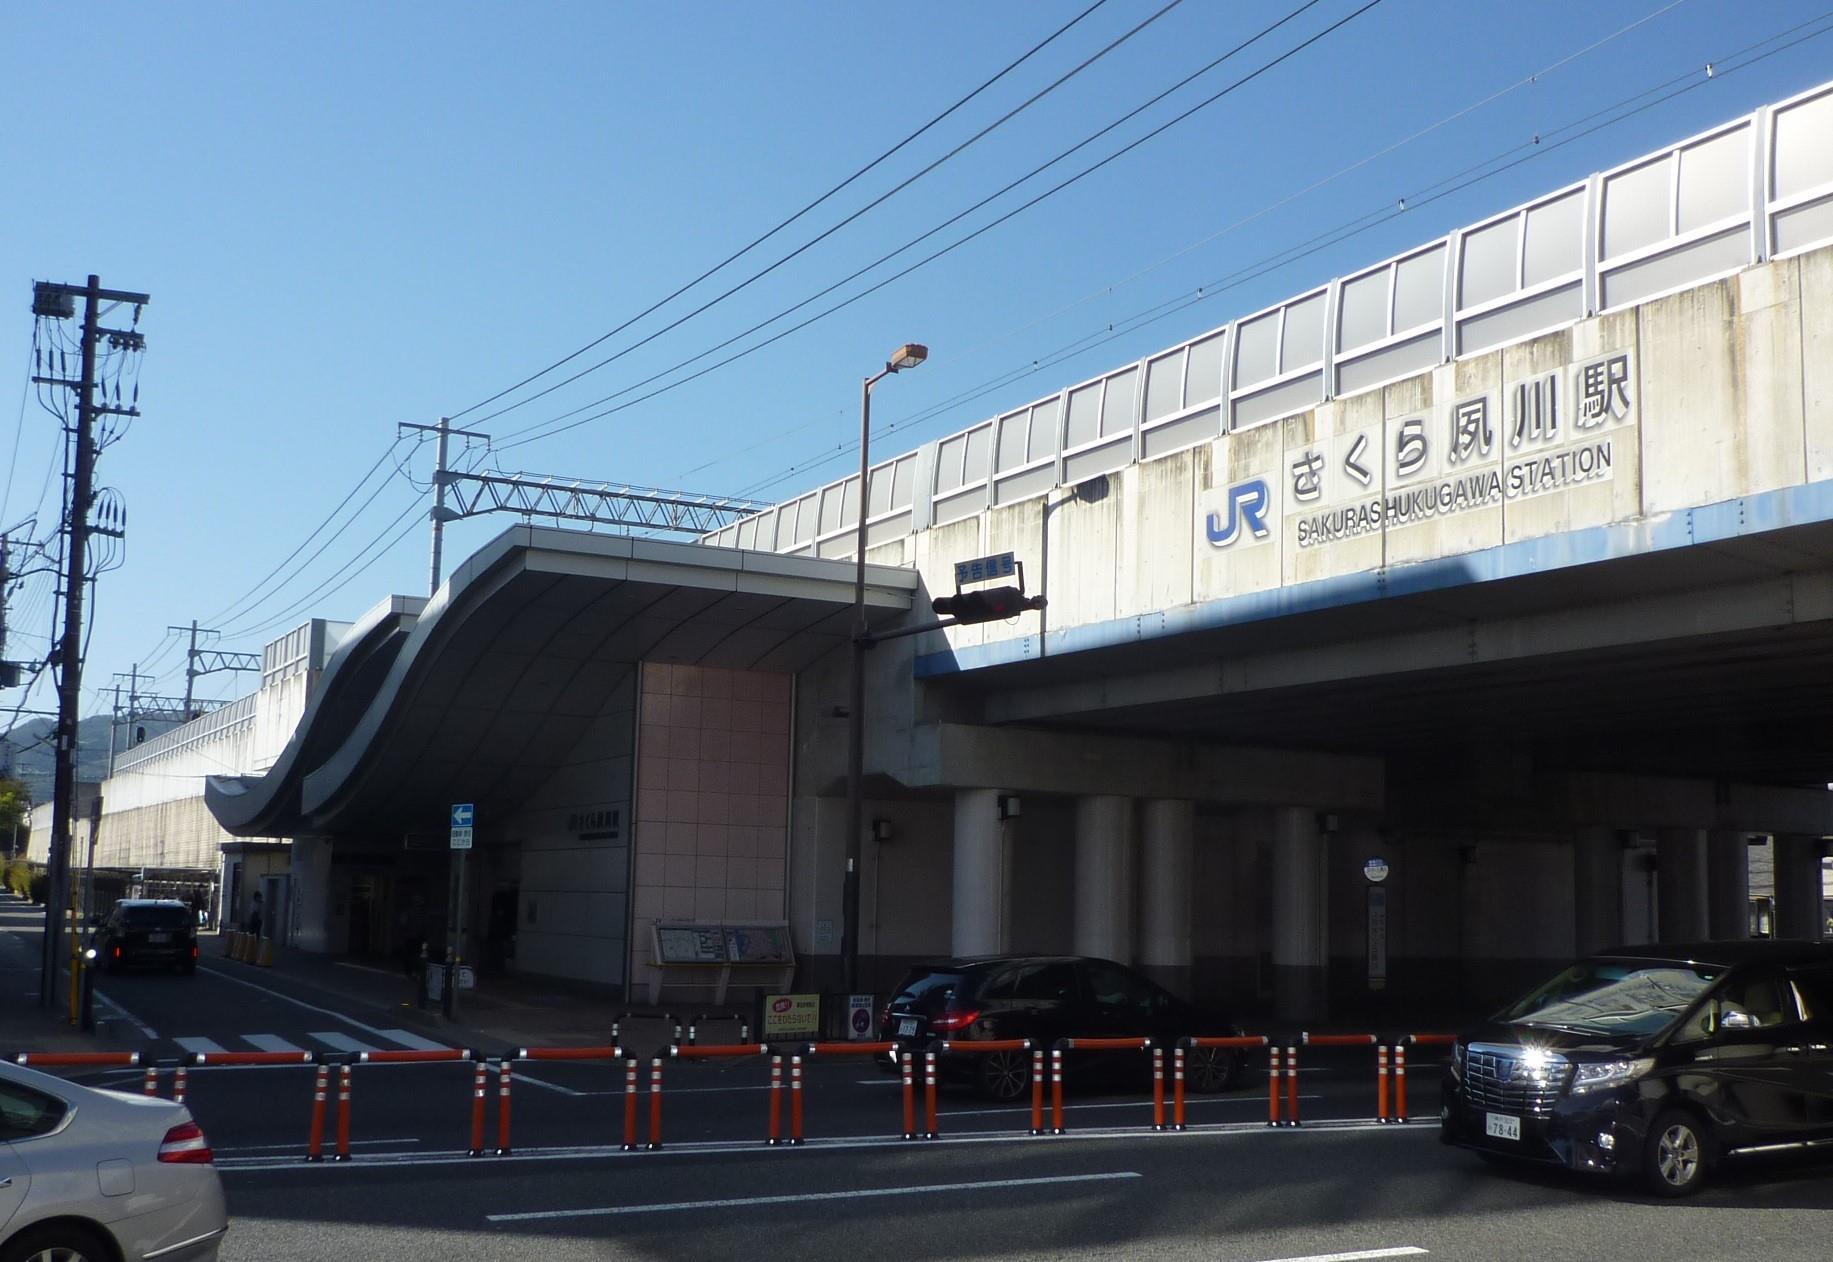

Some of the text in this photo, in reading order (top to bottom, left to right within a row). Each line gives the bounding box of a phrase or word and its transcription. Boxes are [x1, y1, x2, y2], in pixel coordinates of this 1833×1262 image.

[1292, 353, 1631, 497] さくら夙川駅
[1206, 479, 1269, 545] JR
[1298, 441, 1612, 541] SAKURASHUKUGAWA STATION
